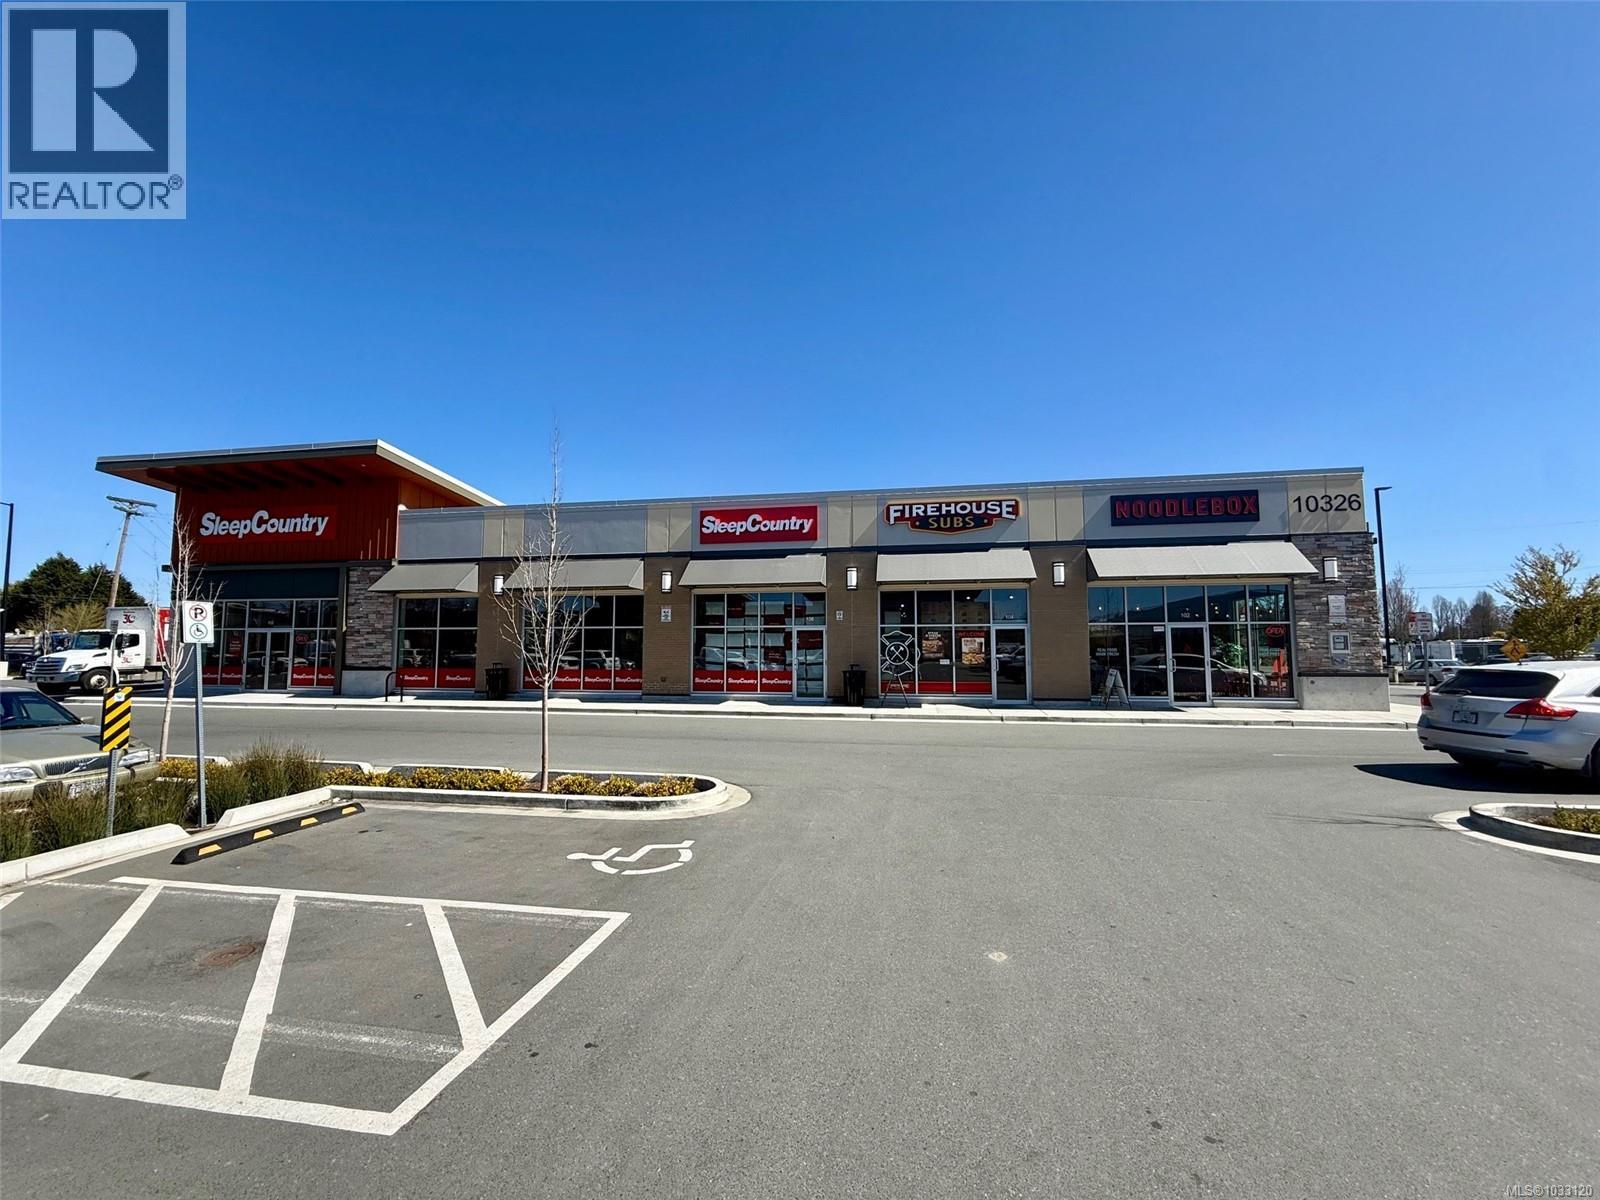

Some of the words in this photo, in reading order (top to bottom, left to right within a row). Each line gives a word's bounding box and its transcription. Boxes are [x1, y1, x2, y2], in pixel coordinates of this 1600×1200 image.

[889, 500, 1017, 525] FIREHOUSE
[1115, 495, 1257, 519] NOODLEBOX
[1292, 494, 1361, 513] 10326
[199, 510, 329, 539] SleepCountry
[701, 513, 814, 536] SleepCountry
[928, 516, 975, 529] SUBS
